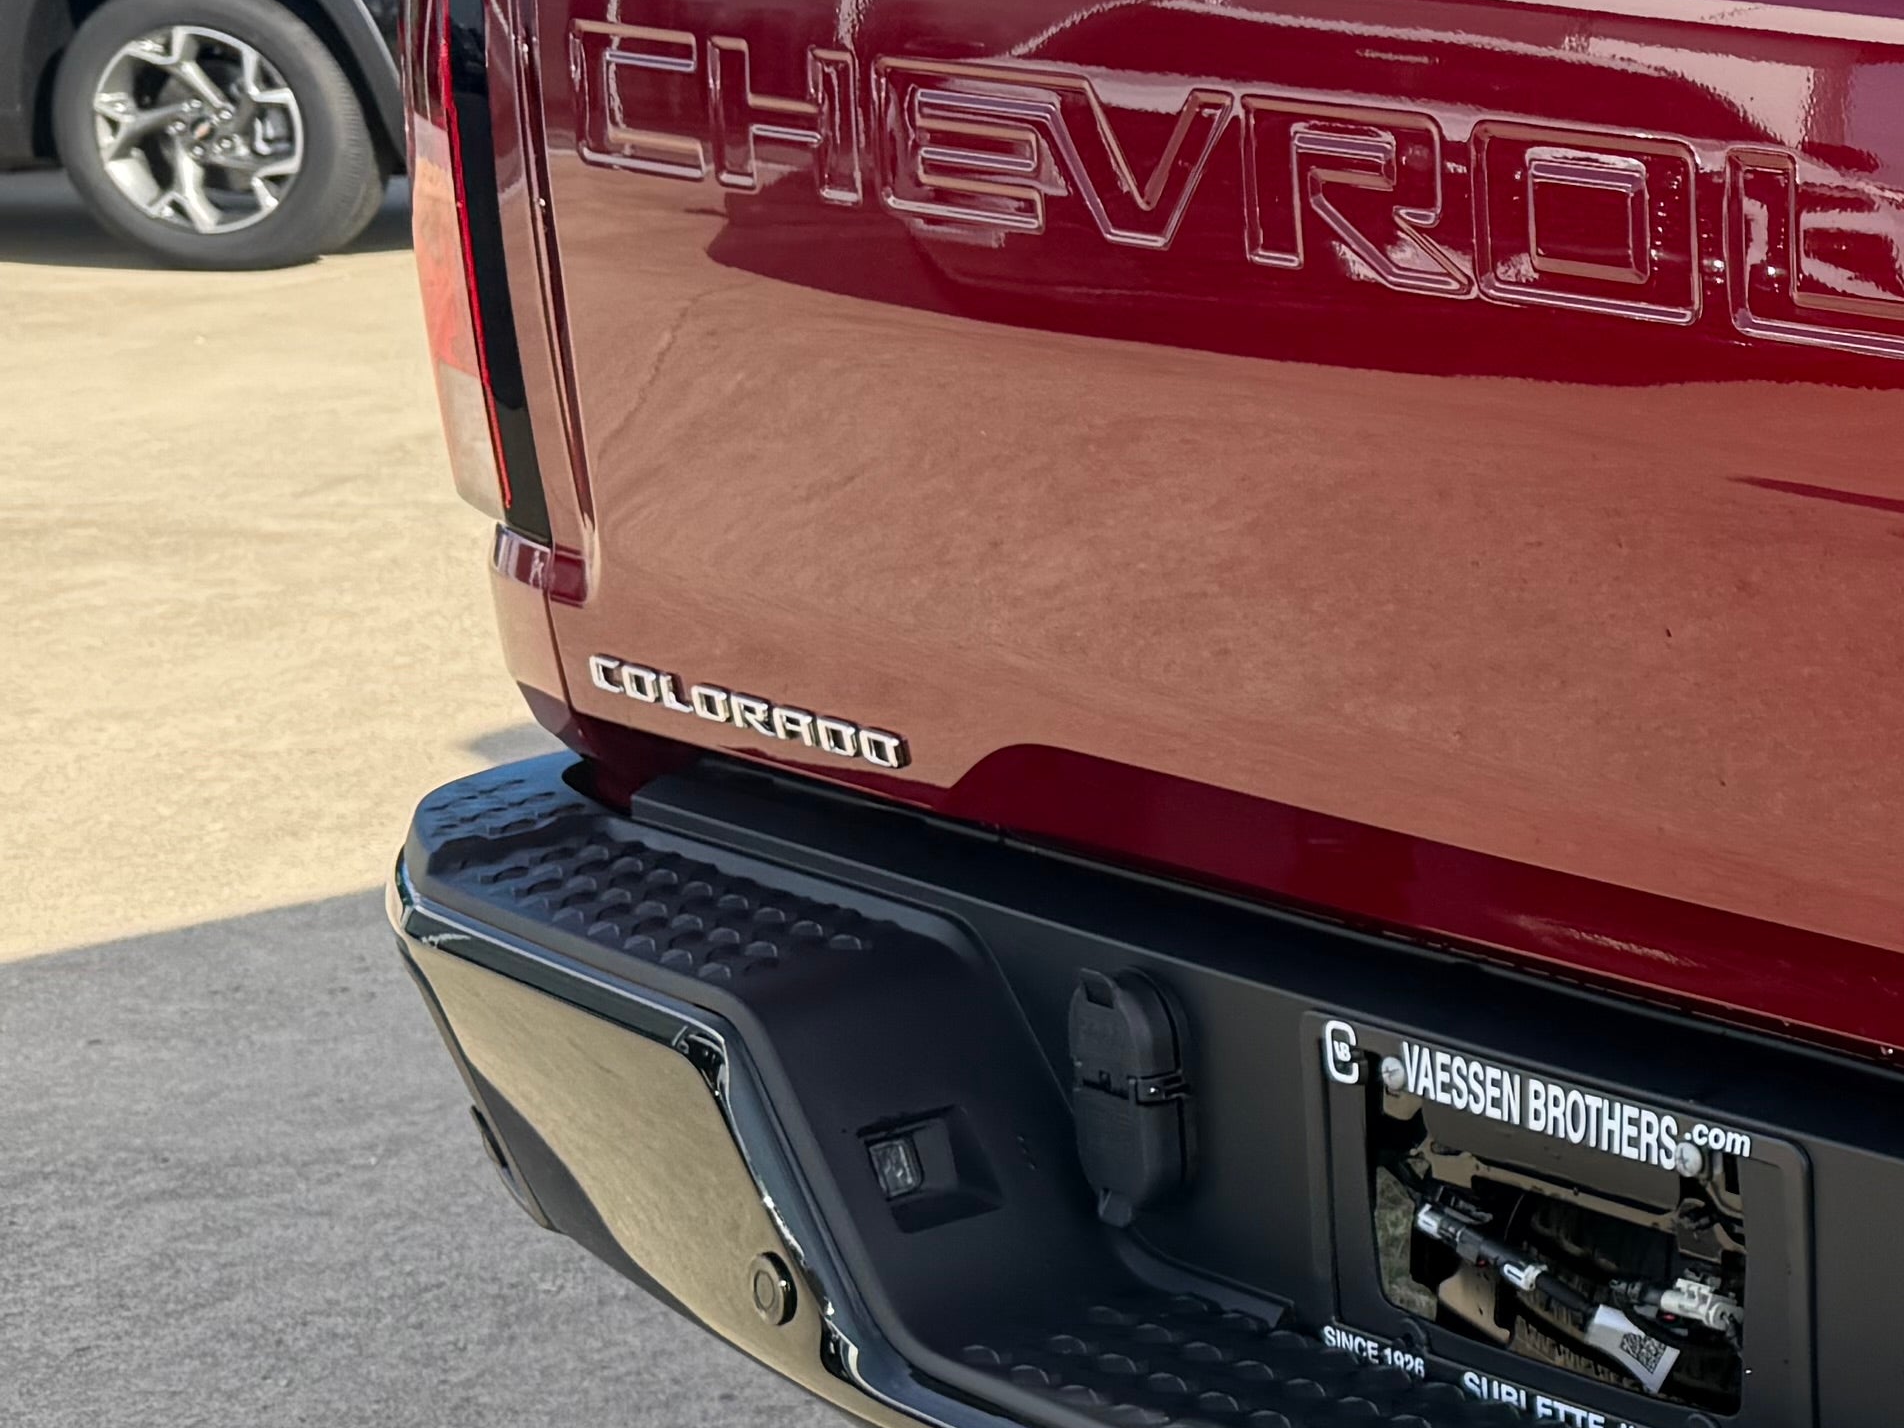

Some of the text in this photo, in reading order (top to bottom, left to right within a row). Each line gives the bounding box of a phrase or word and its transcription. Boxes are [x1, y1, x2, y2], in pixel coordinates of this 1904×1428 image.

[588, 654, 910, 769] COLORADO
[1402, 1041, 1520, 1125] VAESSEN
[1323, 1326, 1379, 1365] SINCE
